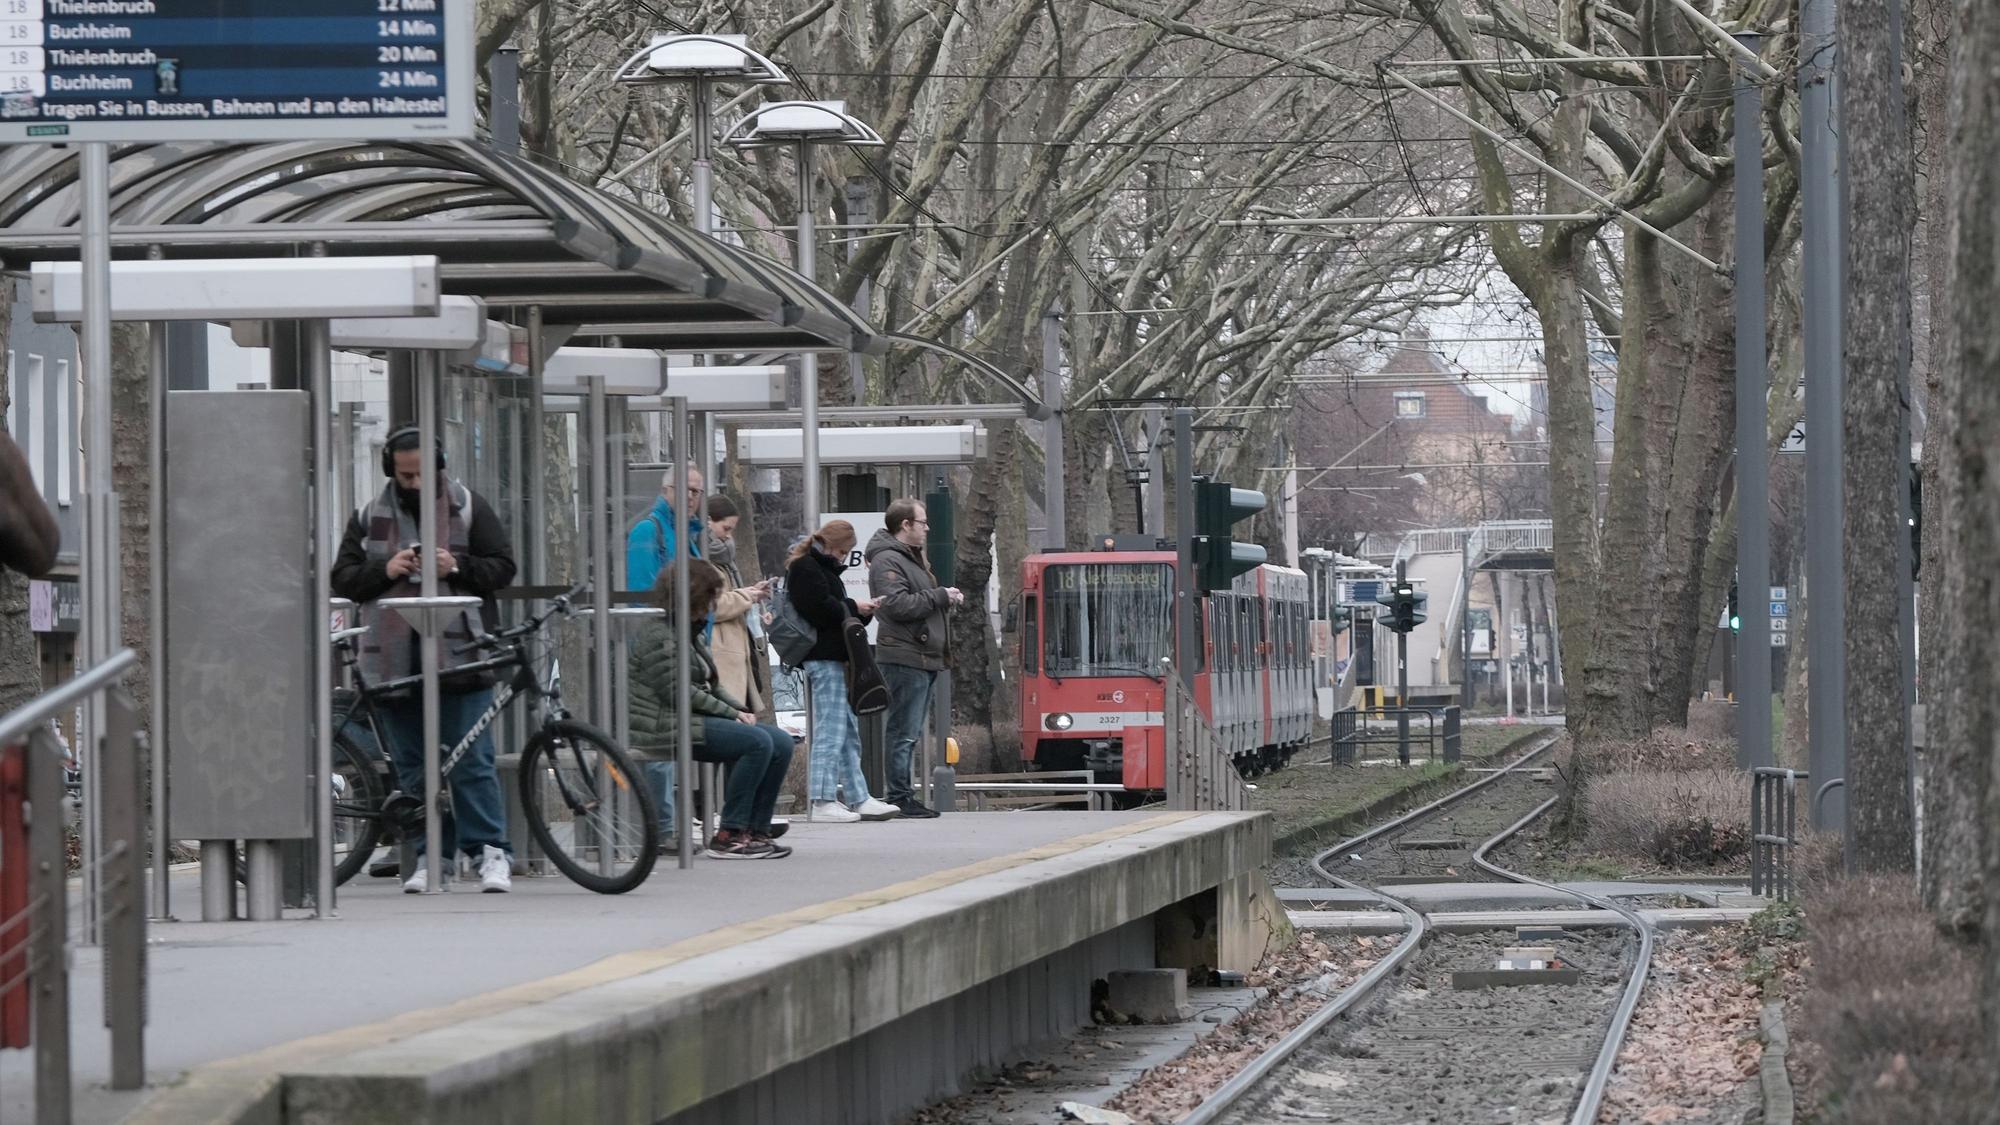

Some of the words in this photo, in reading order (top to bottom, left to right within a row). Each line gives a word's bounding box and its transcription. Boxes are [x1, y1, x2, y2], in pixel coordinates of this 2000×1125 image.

[9, 0, 27, 13] 18
[49, 0, 156, 14] Thielenbruch
[378, 0, 399, 11] 12
[402, 0, 436, 11] Min
[10, 25, 28, 39] 18
[49, 23, 132, 39] Buchheim
[378, 20, 400, 36] 14
[402, 20, 437, 36] Min
[10, 51, 29, 64] 18
[49, 48, 157, 65] Thielenbruch
[378, 46, 401, 62] 20
[403, 46, 437, 62] Min
[11, 76, 29, 90] 18
[51, 74, 133, 90] Buchheim
[378, 71, 401, 88] 24
[403, 71, 438, 87] Min
[42, 102, 96, 119] tragen
[98, 100, 125, 116] Sie
[126, 100, 144, 116] in
[146, 100, 210, 118] Bussen,
[212, 98, 275, 115] Bahnen
[278, 97, 311, 115] und
[313, 101, 335, 114] an
[337, 96, 370, 114] den
[1058, 570, 1074, 589] 18
[1099, 716, 1120, 724] 2327
